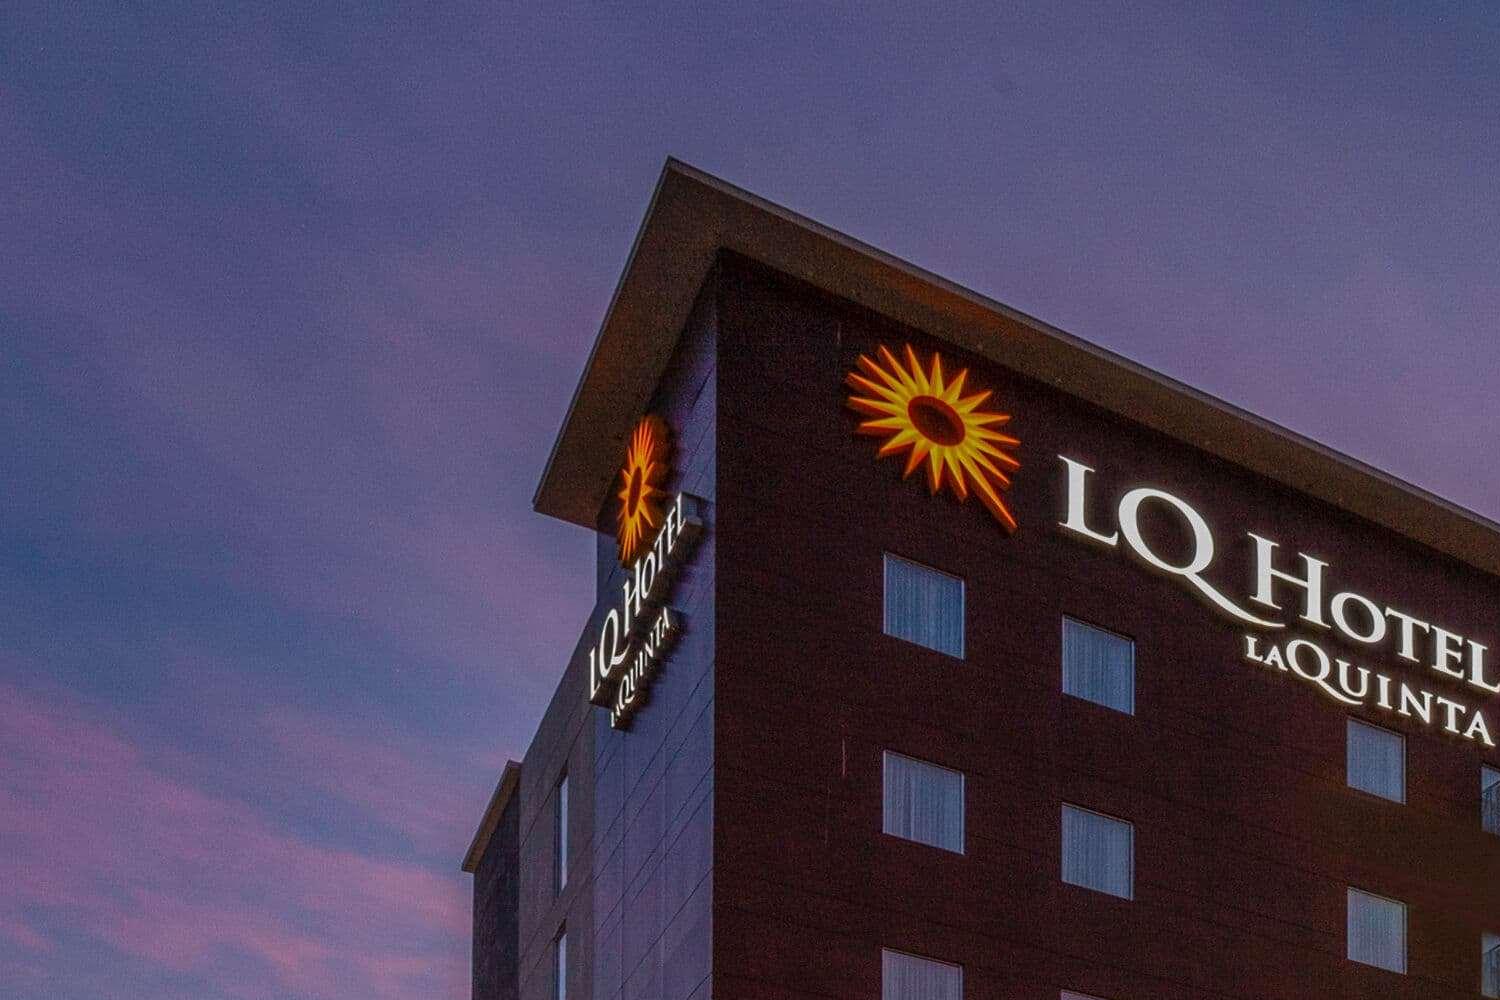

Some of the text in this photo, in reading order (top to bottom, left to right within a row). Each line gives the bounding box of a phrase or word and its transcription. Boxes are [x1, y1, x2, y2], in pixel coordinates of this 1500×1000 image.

[588, 491, 687, 701] LQ HOTEL
[1057, 454, 1286, 629] LQ
